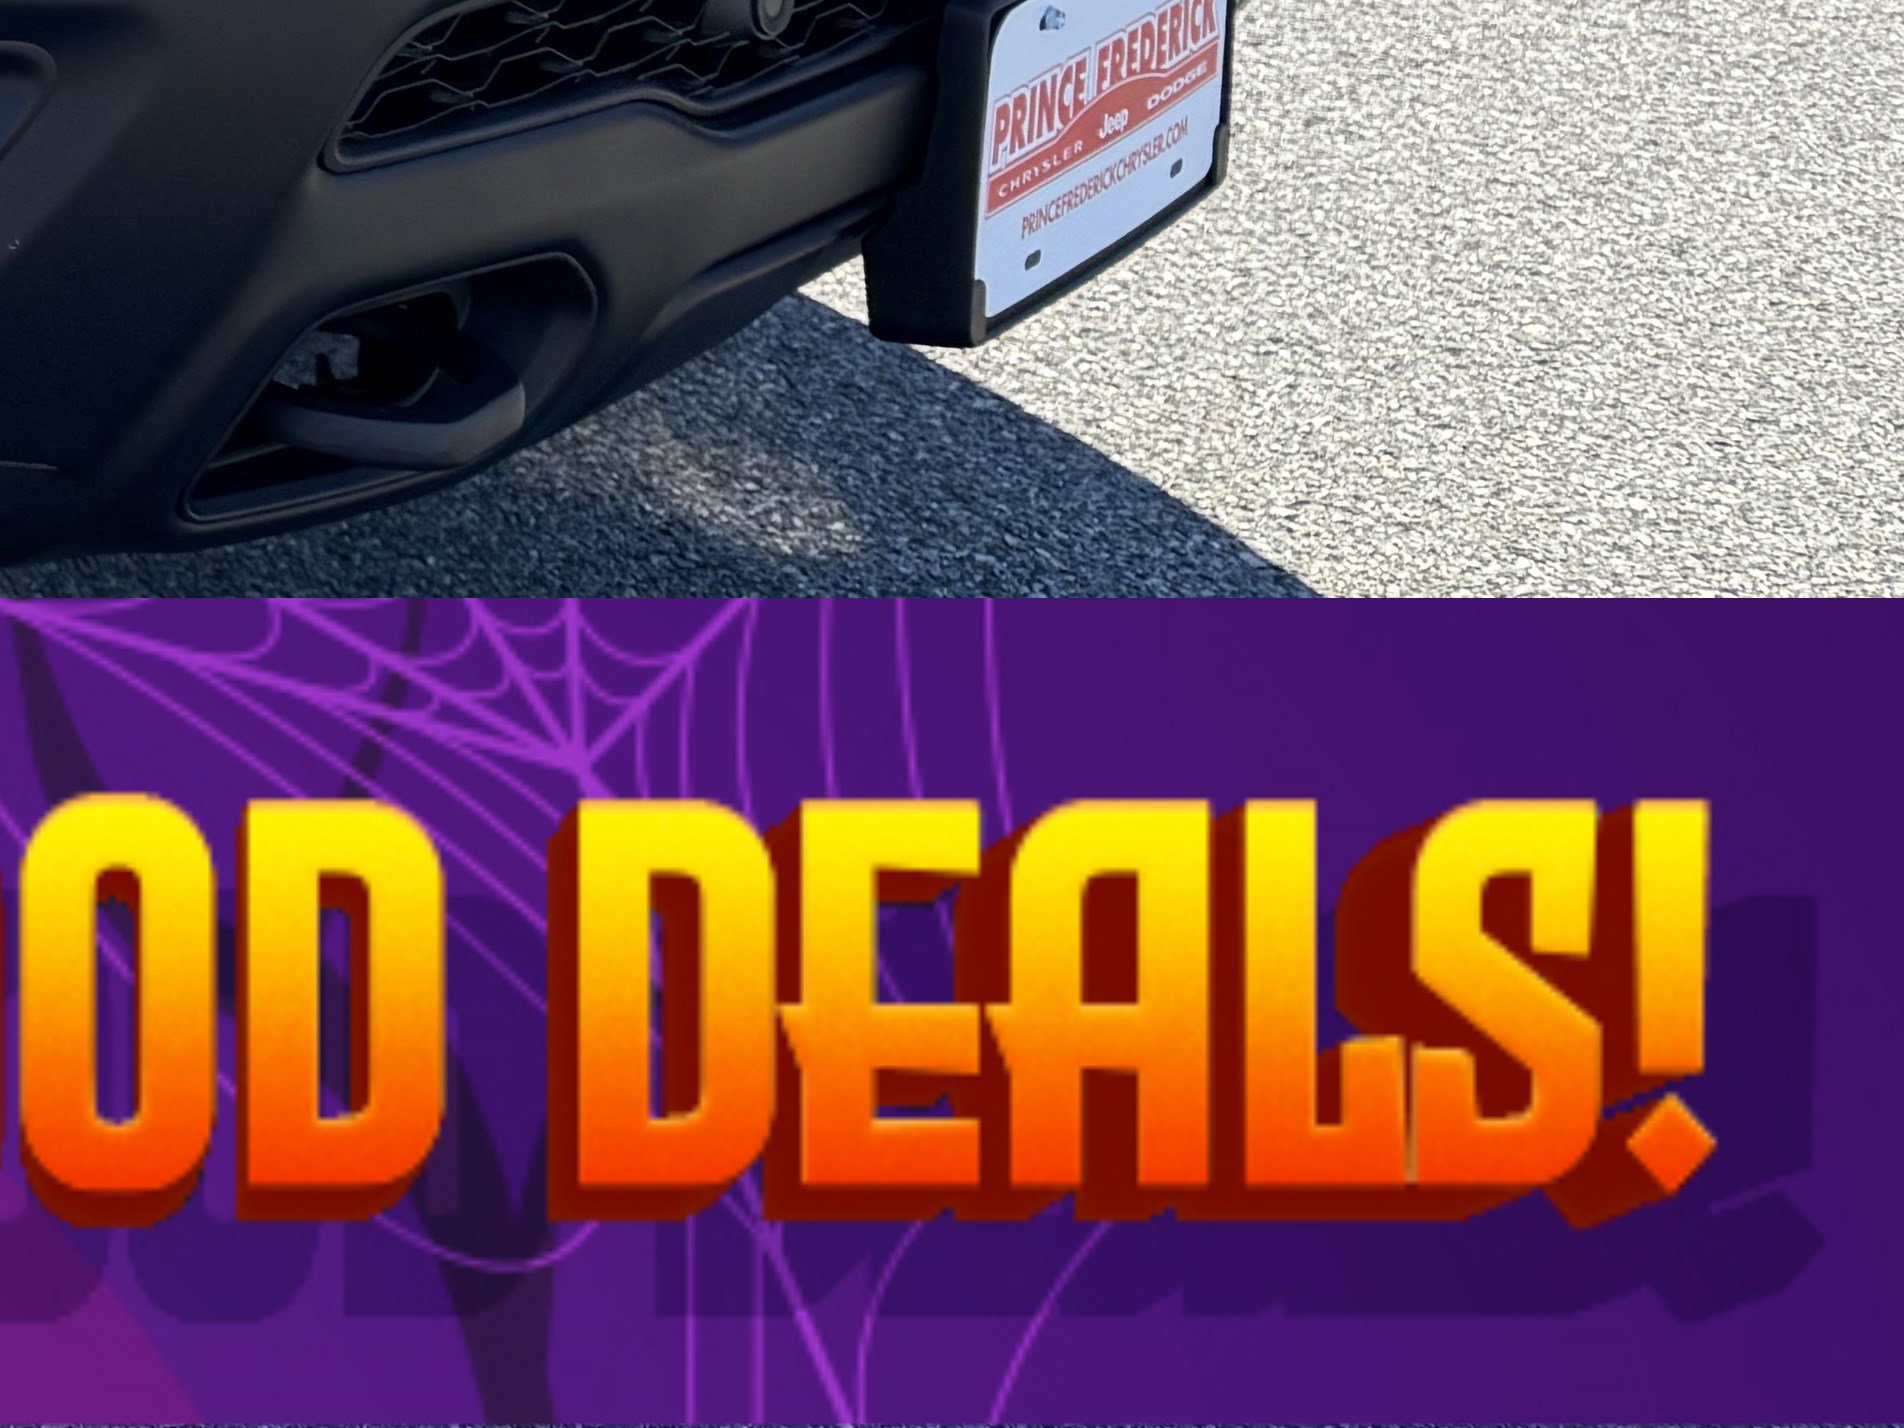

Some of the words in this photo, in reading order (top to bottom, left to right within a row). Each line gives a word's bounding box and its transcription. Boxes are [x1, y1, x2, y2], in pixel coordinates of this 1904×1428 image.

[991, 54, 1089, 166] PRINCE
[998, 139, 1084, 198] CHRYSLER
[1098, 107, 1130, 140] Jeep
[1146, 60, 1209, 111] DODGE
[1020, 116, 1189, 240] PRINCEFREDERICKCHRYSLER.COM
